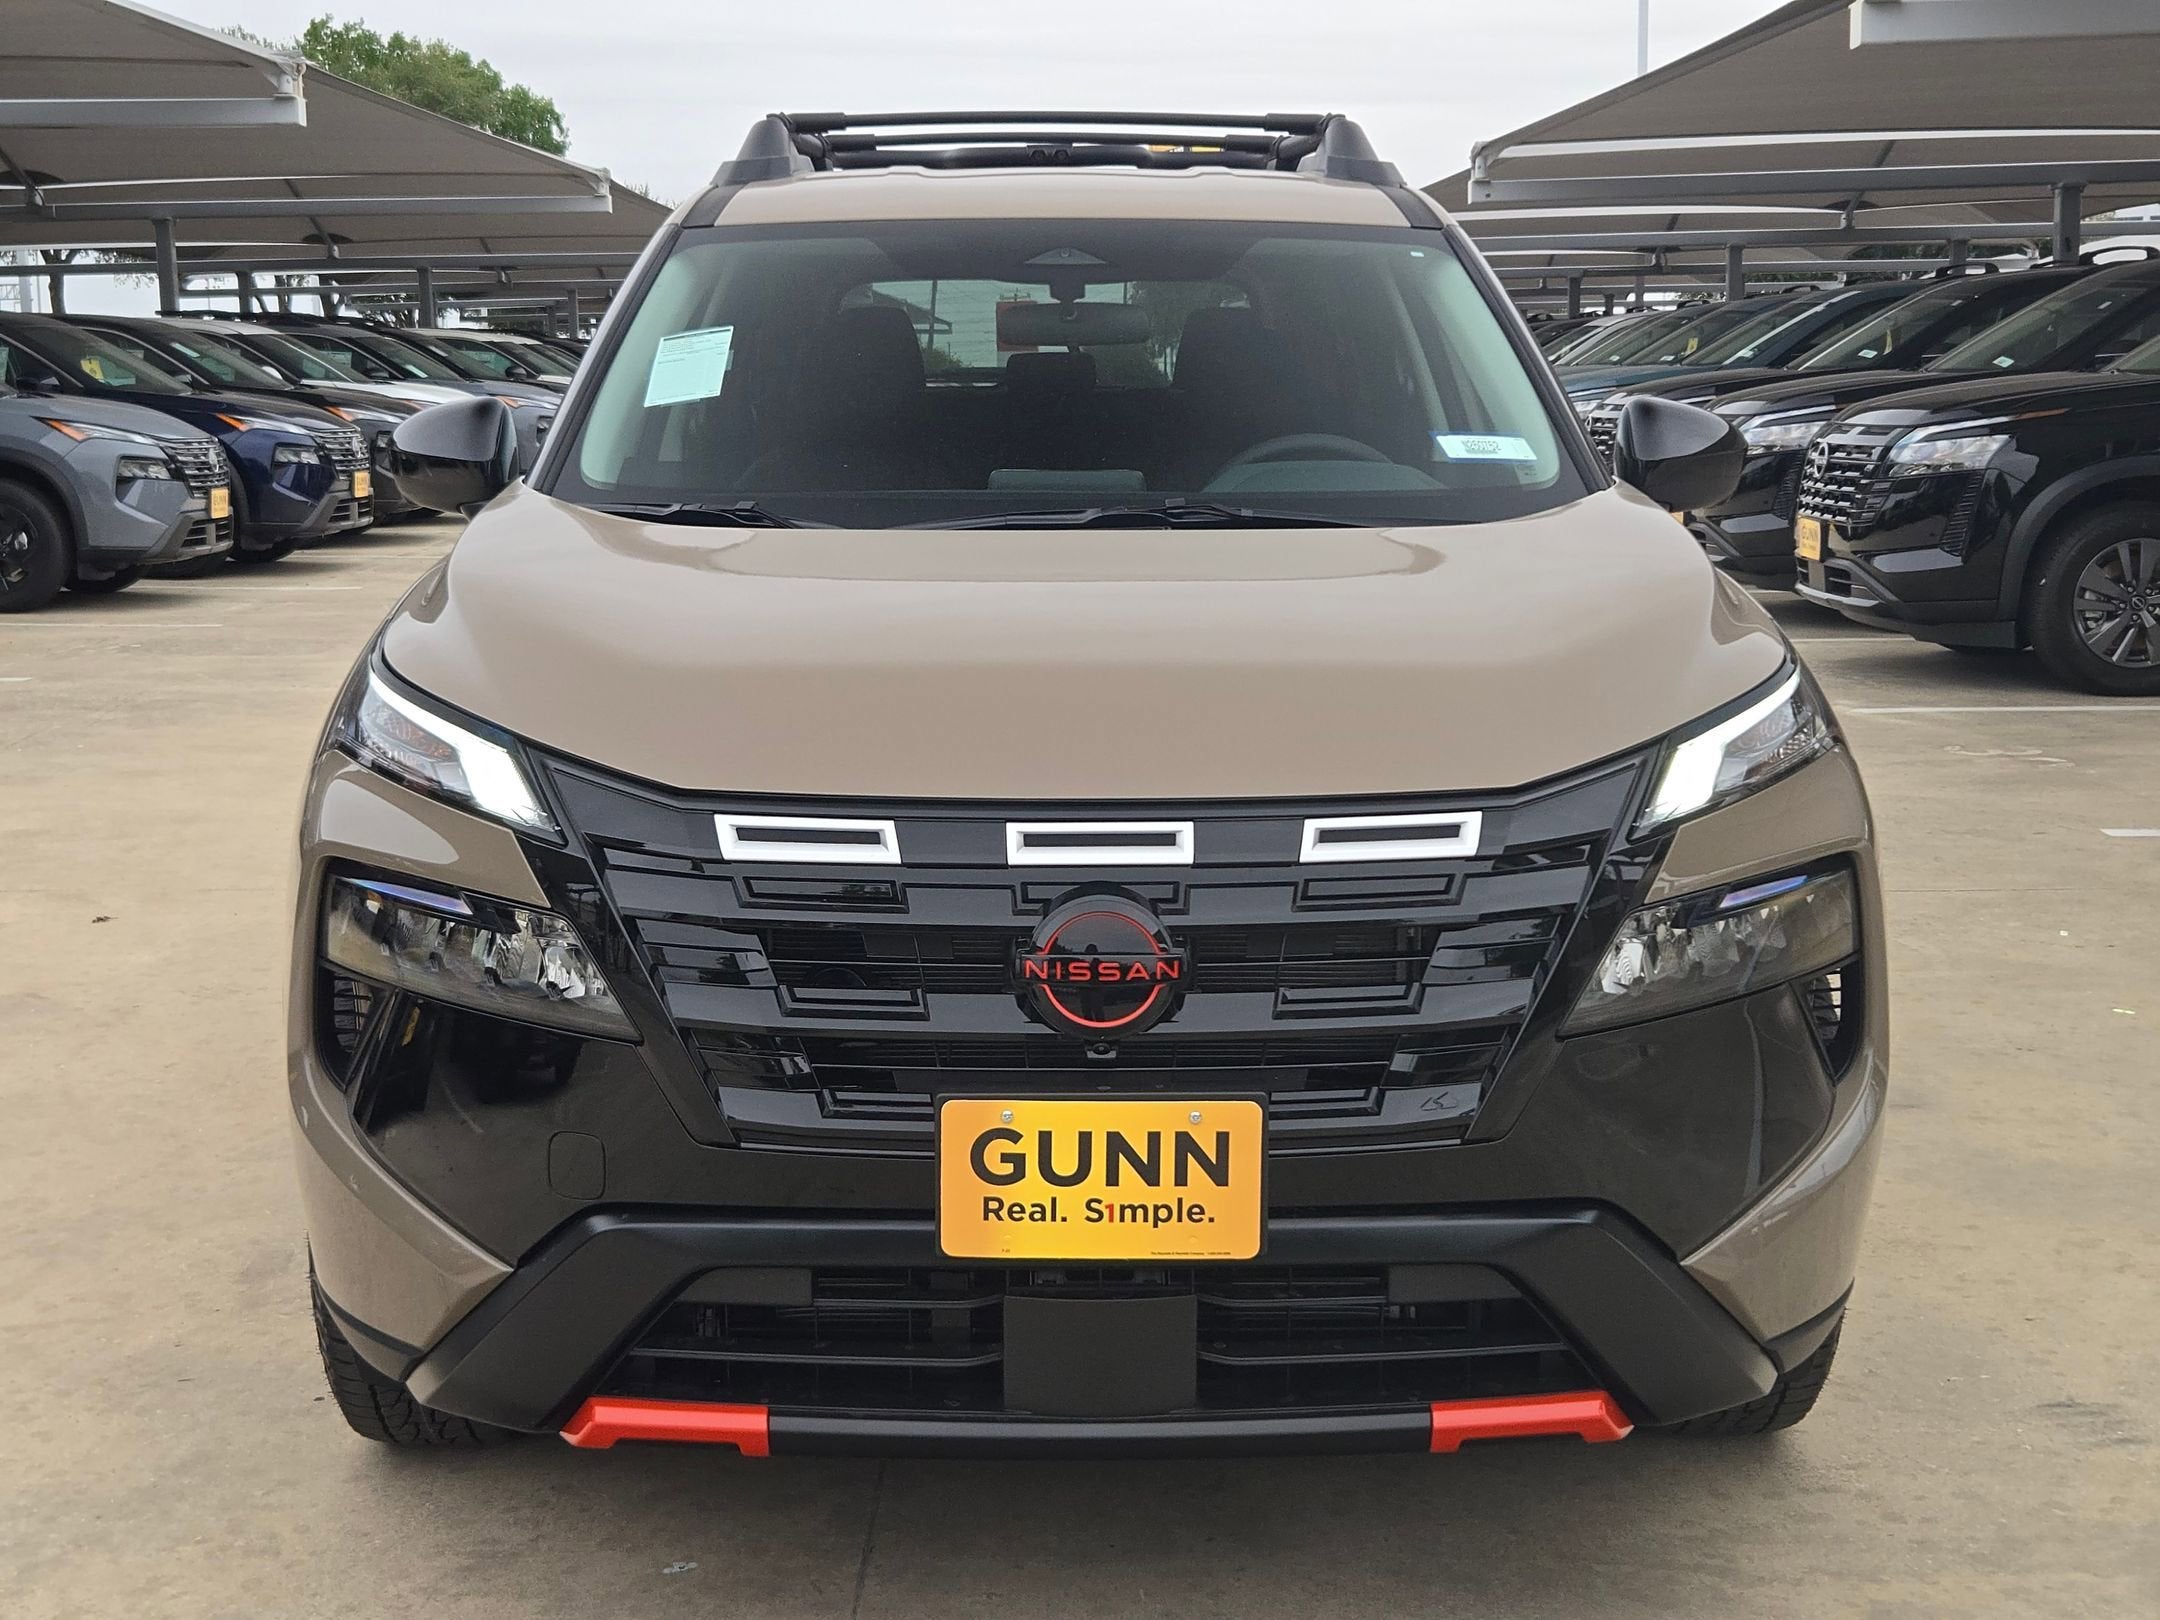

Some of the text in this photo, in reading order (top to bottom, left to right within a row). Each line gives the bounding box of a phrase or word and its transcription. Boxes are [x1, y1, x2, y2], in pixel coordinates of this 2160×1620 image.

[1023, 960, 1180, 982] NISSAN
[969, 1127, 1231, 1188] GUNN
[982, 1196, 1216, 1229] Real. S1mple.
